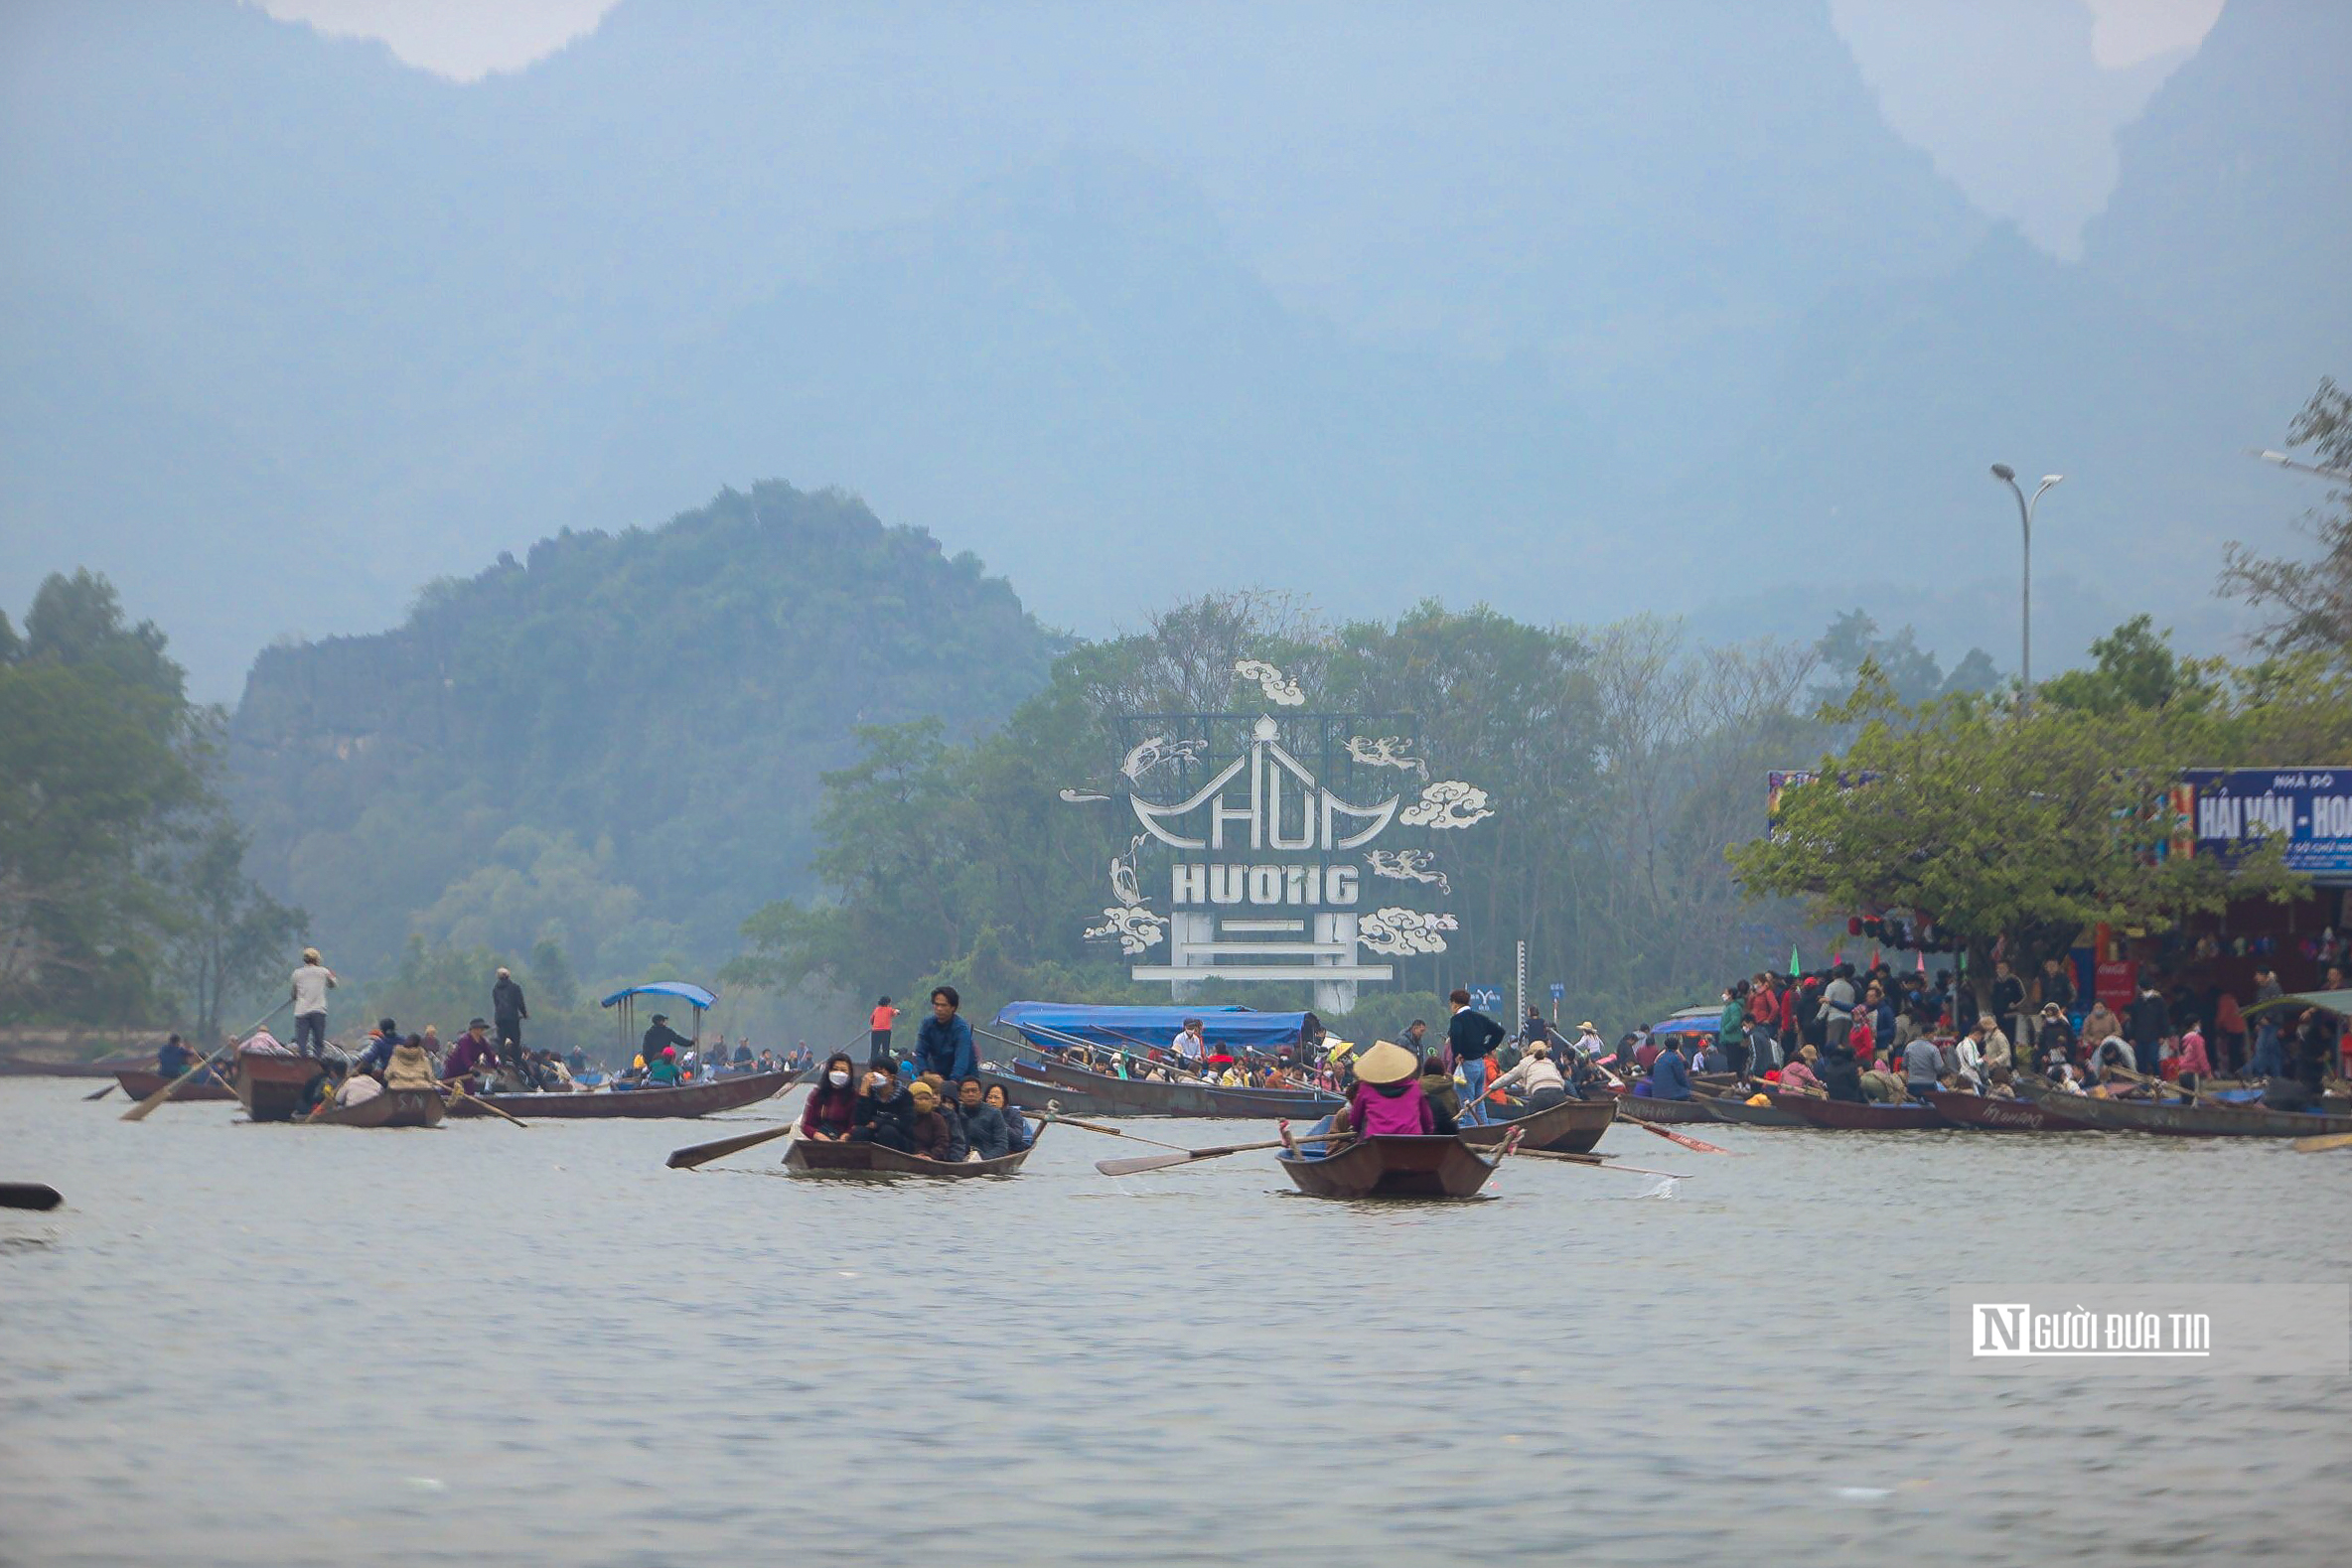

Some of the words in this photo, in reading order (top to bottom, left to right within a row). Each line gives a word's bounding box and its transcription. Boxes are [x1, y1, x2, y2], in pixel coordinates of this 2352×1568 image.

[2199, 786, 2241, 839] HẢI
[2244, 788, 2294, 839] VÂN
[1172, 864, 1359, 905] HƯƠNG
